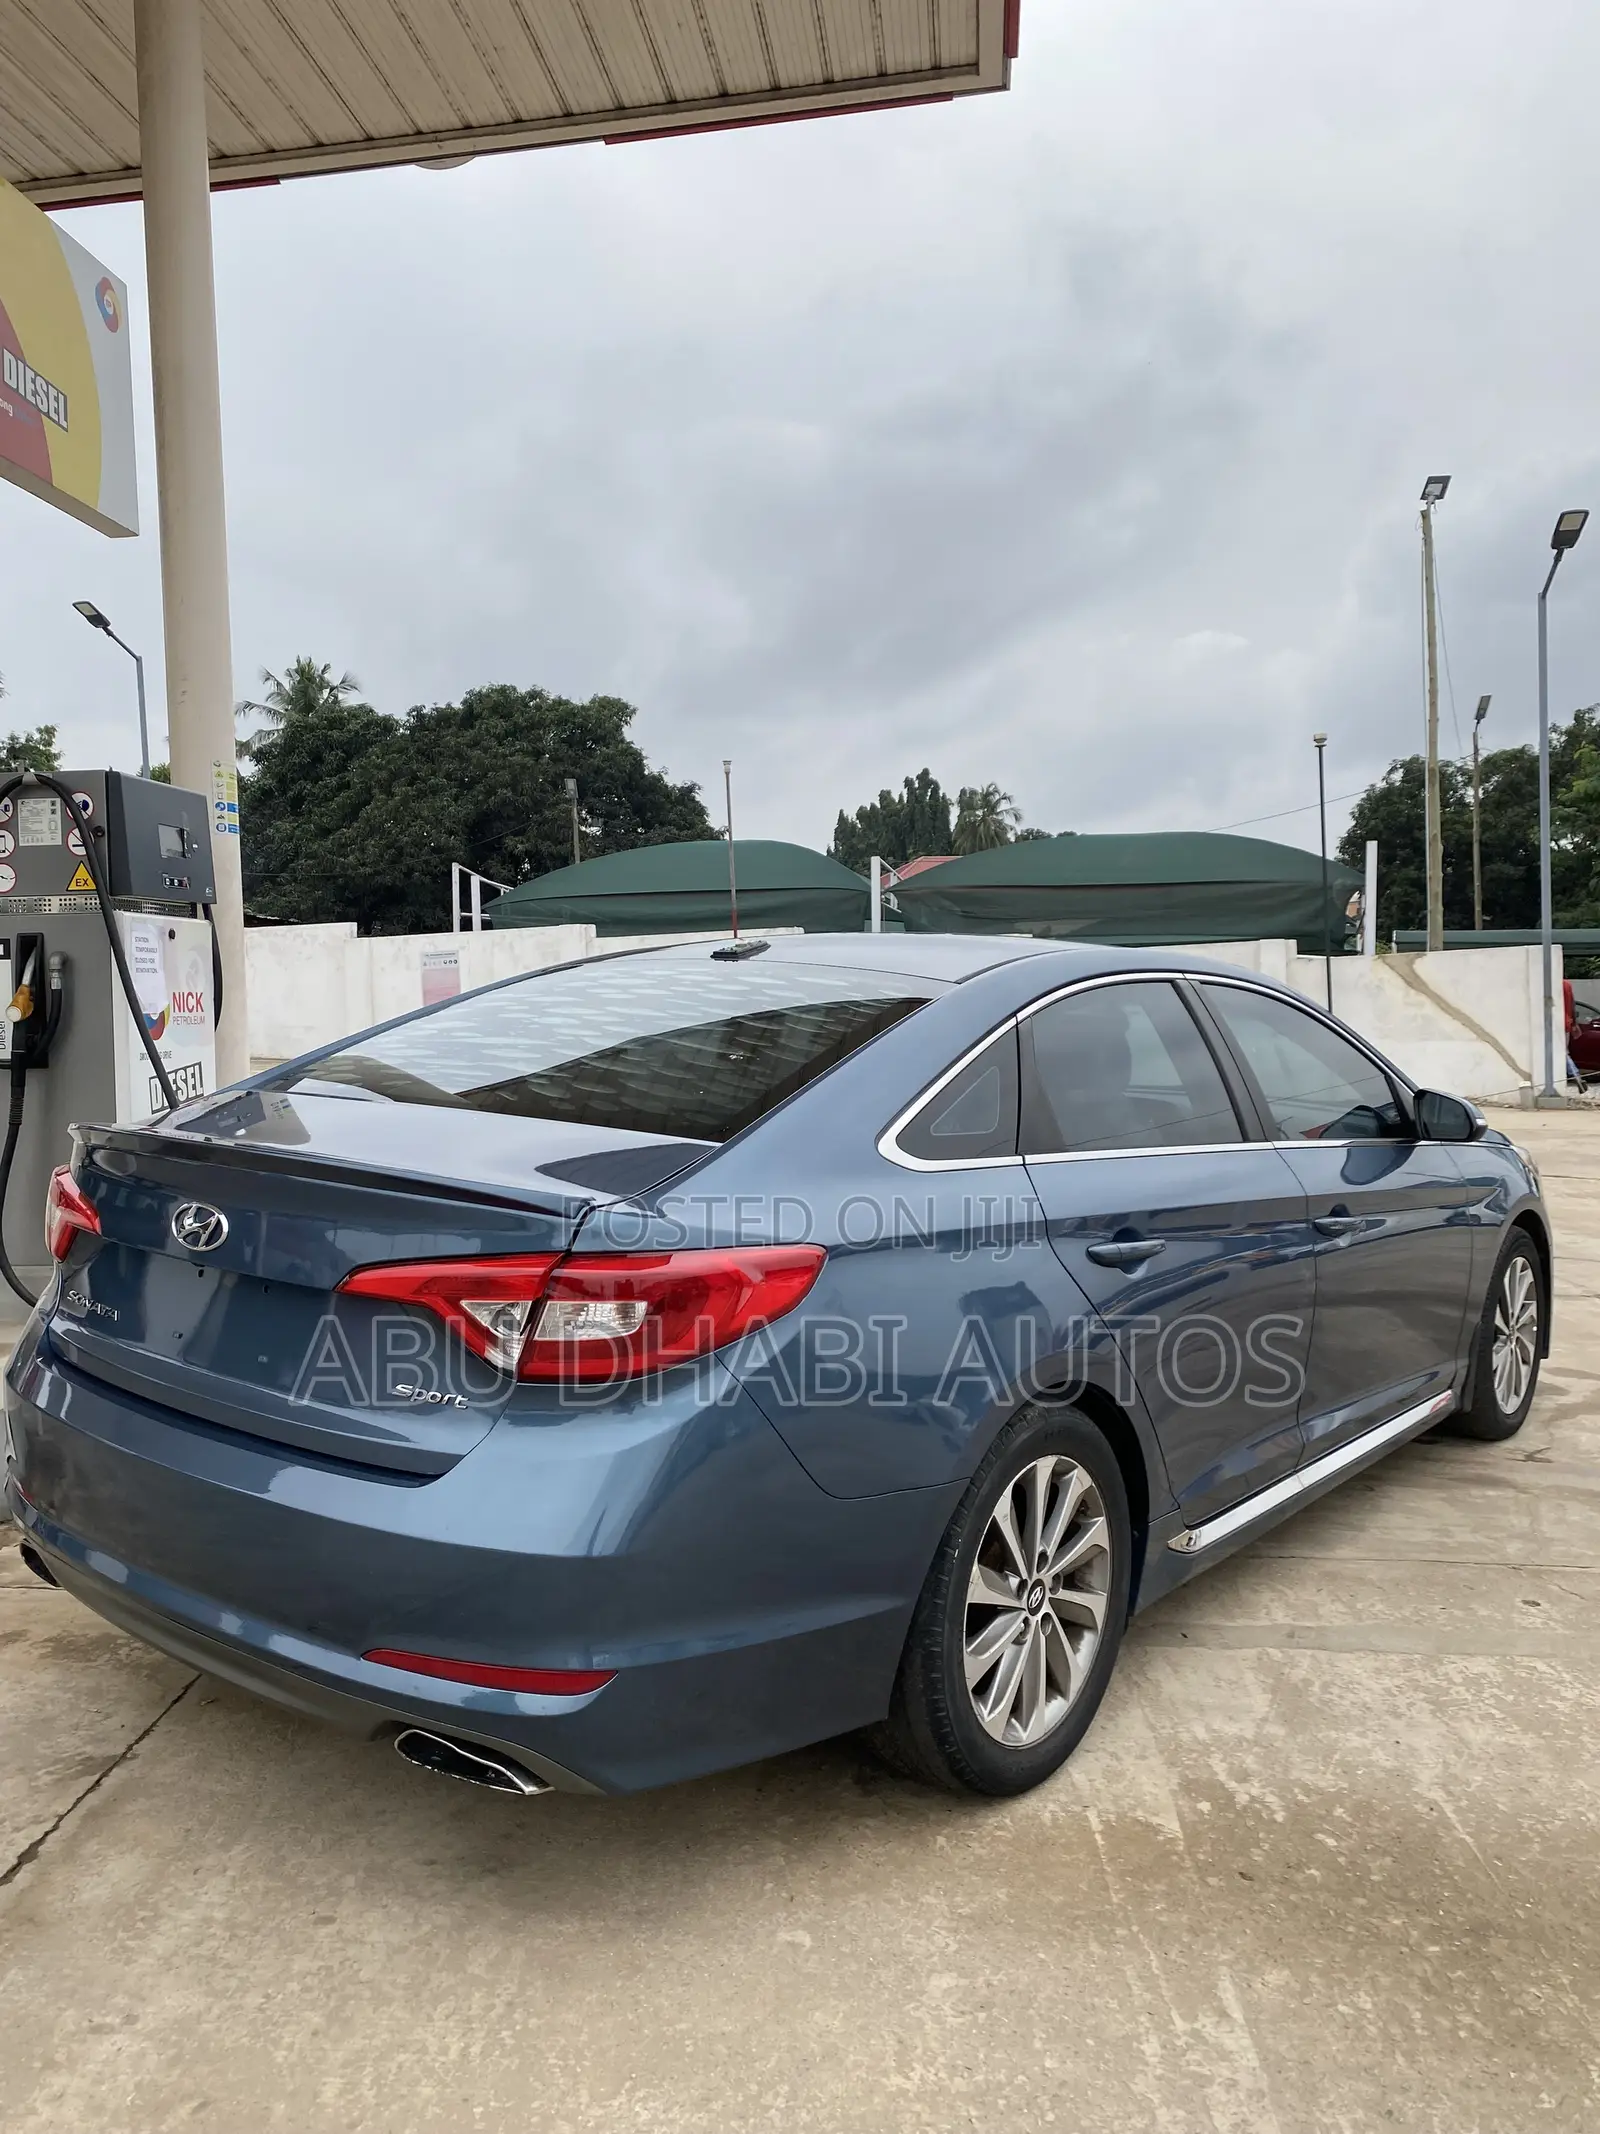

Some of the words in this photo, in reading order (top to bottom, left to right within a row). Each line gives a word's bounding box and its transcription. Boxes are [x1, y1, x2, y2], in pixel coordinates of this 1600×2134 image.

[3, 348, 68, 429] DIESEL
[75, 878, 89, 887] EX
[172, 991, 204, 1013] NICK
[172, 1015, 206, 1026] PETROLEUM
[67, 1290, 119, 1321] SONATA
[391, 1383, 470, 1409] Sport
